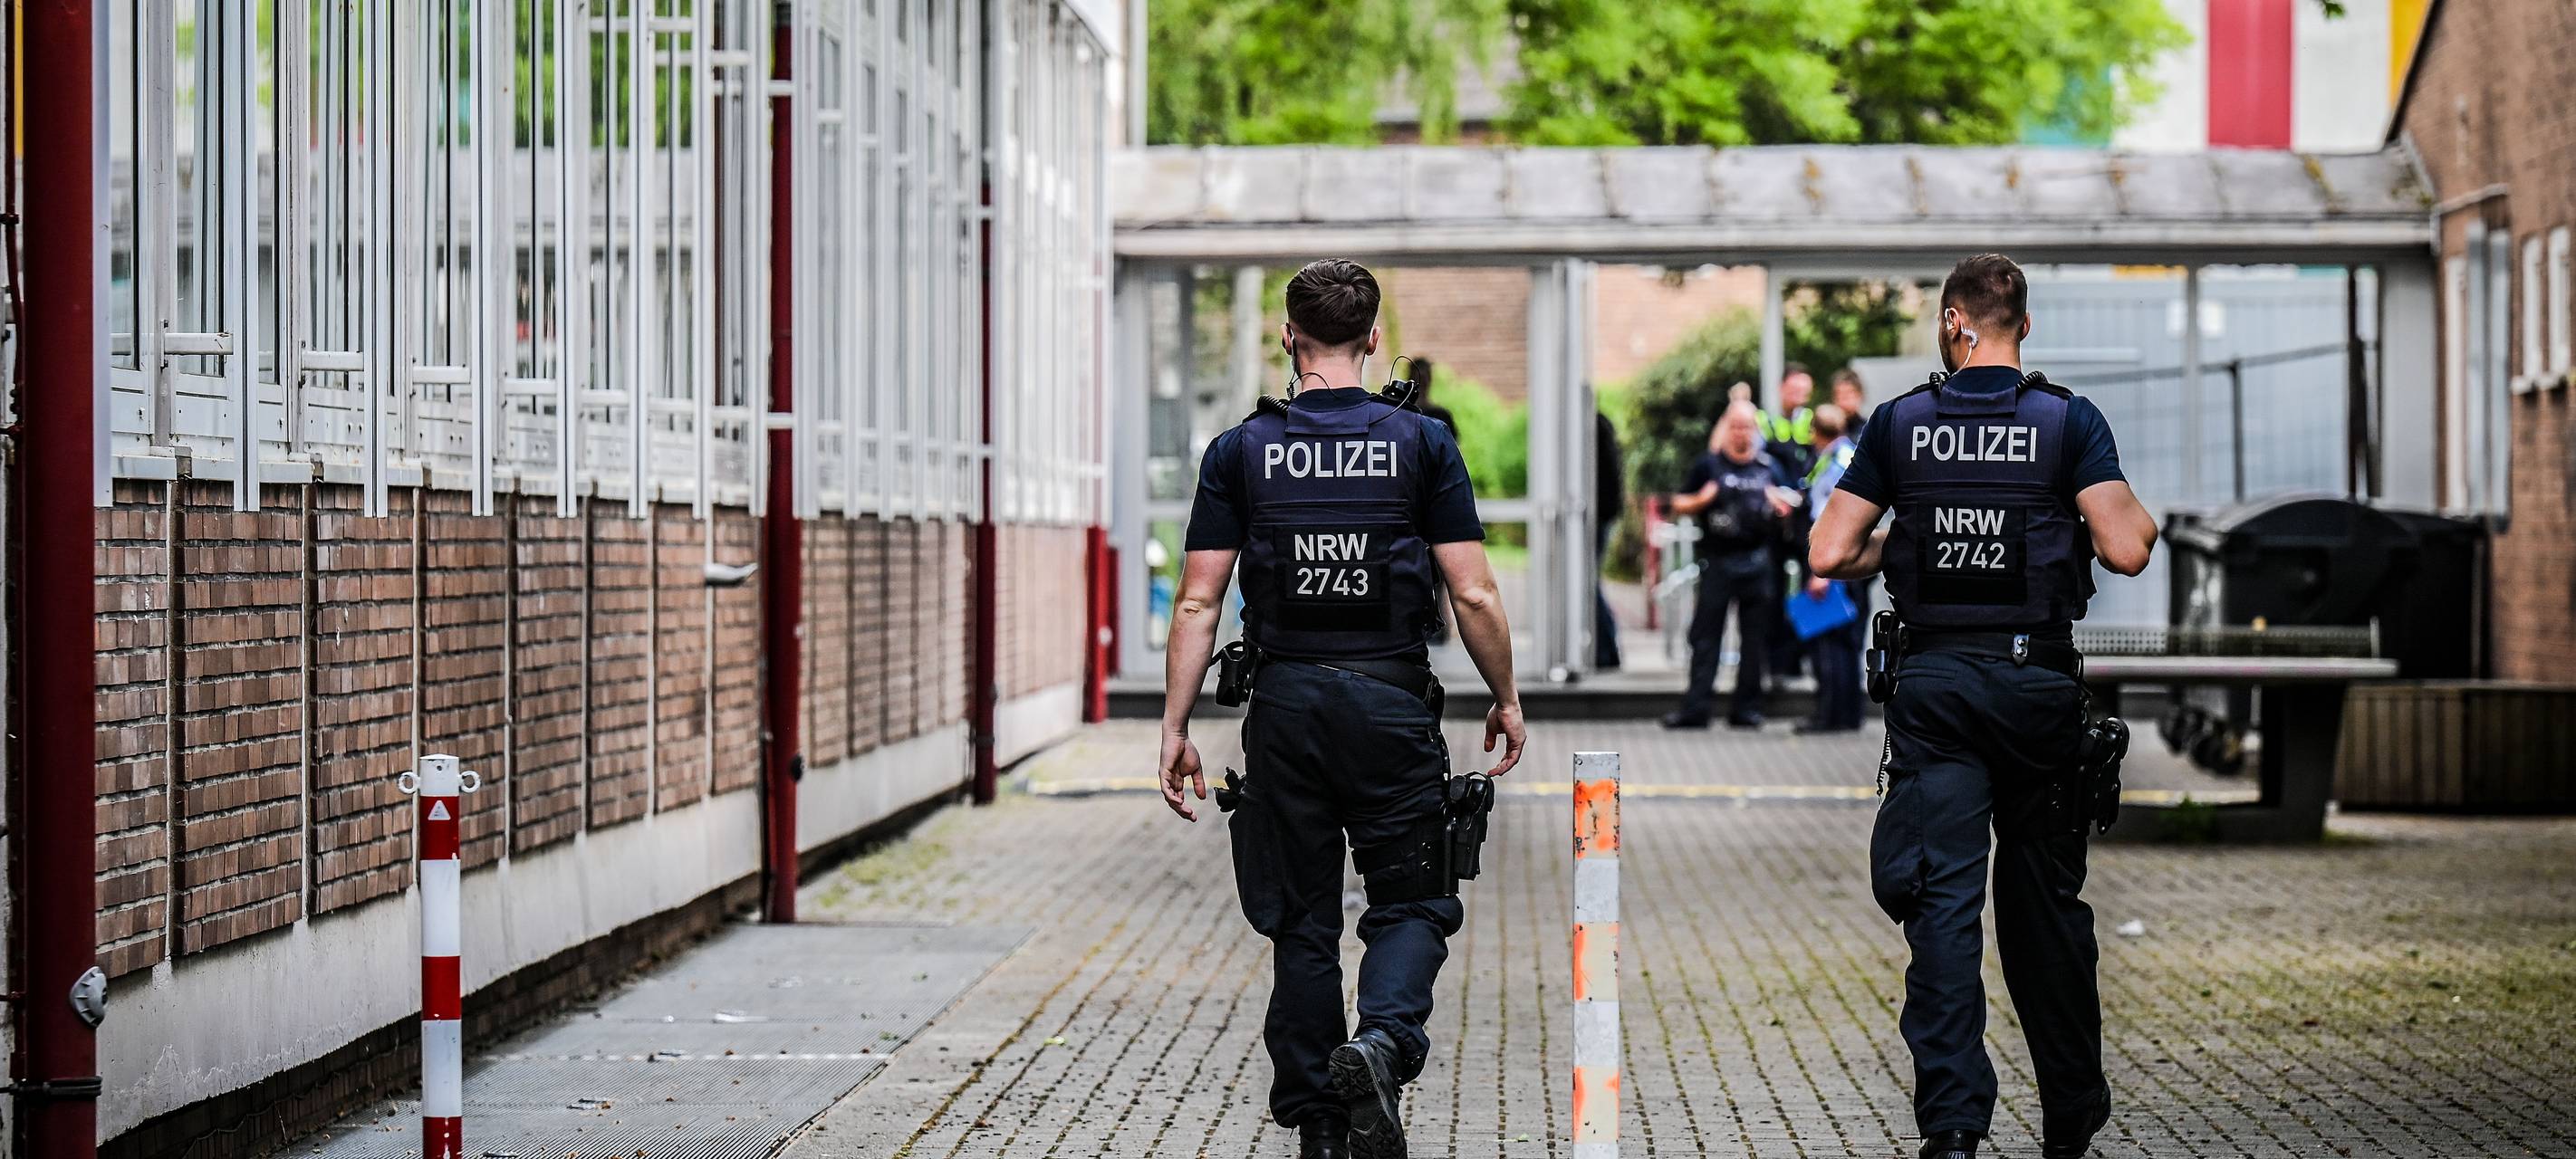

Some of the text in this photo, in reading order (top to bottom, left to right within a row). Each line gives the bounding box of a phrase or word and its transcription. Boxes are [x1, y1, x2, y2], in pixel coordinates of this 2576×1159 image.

[1911, 425, 2037, 462] POLIZEI
[1264, 441, 1398, 479] POLIZEI
[1935, 507, 2005, 535] NRW
[1294, 532, 1368, 560] NRW
[1937, 541, 2005, 569] 2742
[1296, 568, 1369, 596] 2743
